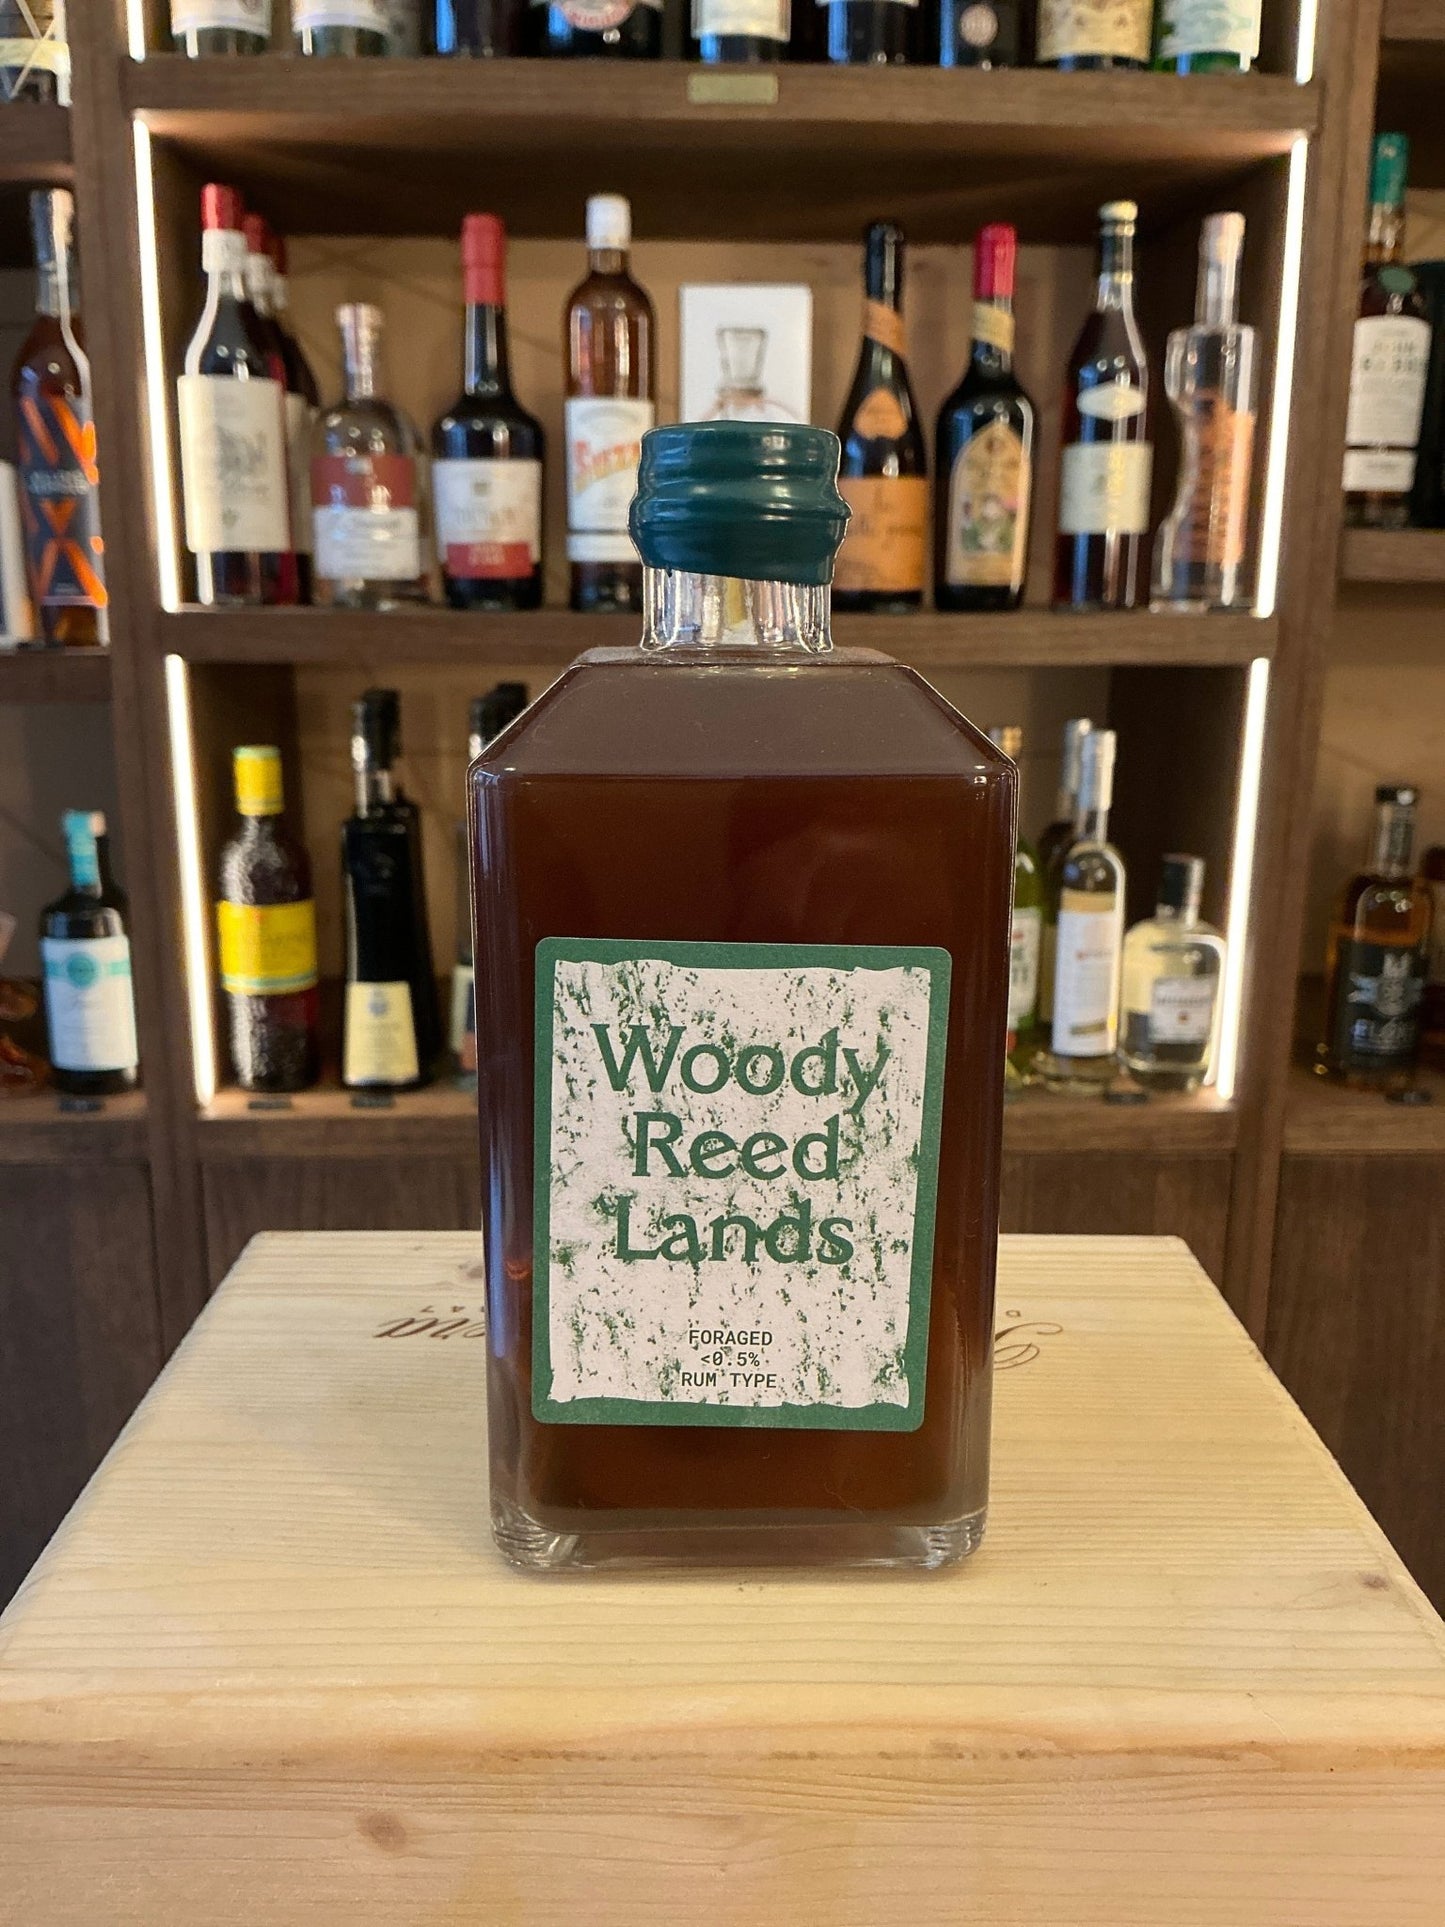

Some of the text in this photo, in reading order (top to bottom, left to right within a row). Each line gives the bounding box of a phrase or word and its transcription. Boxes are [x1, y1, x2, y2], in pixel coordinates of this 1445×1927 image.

[591, 1022, 892, 1115] Woody
[631, 1110, 841, 1181] Reed
[613, 1194, 855, 1266] Lands
[688, 1329, 774, 1346] FORAGED
[700, 1351, 761, 1367] <0.5%
[681, 1371, 778, 1388] RUM TYPE
